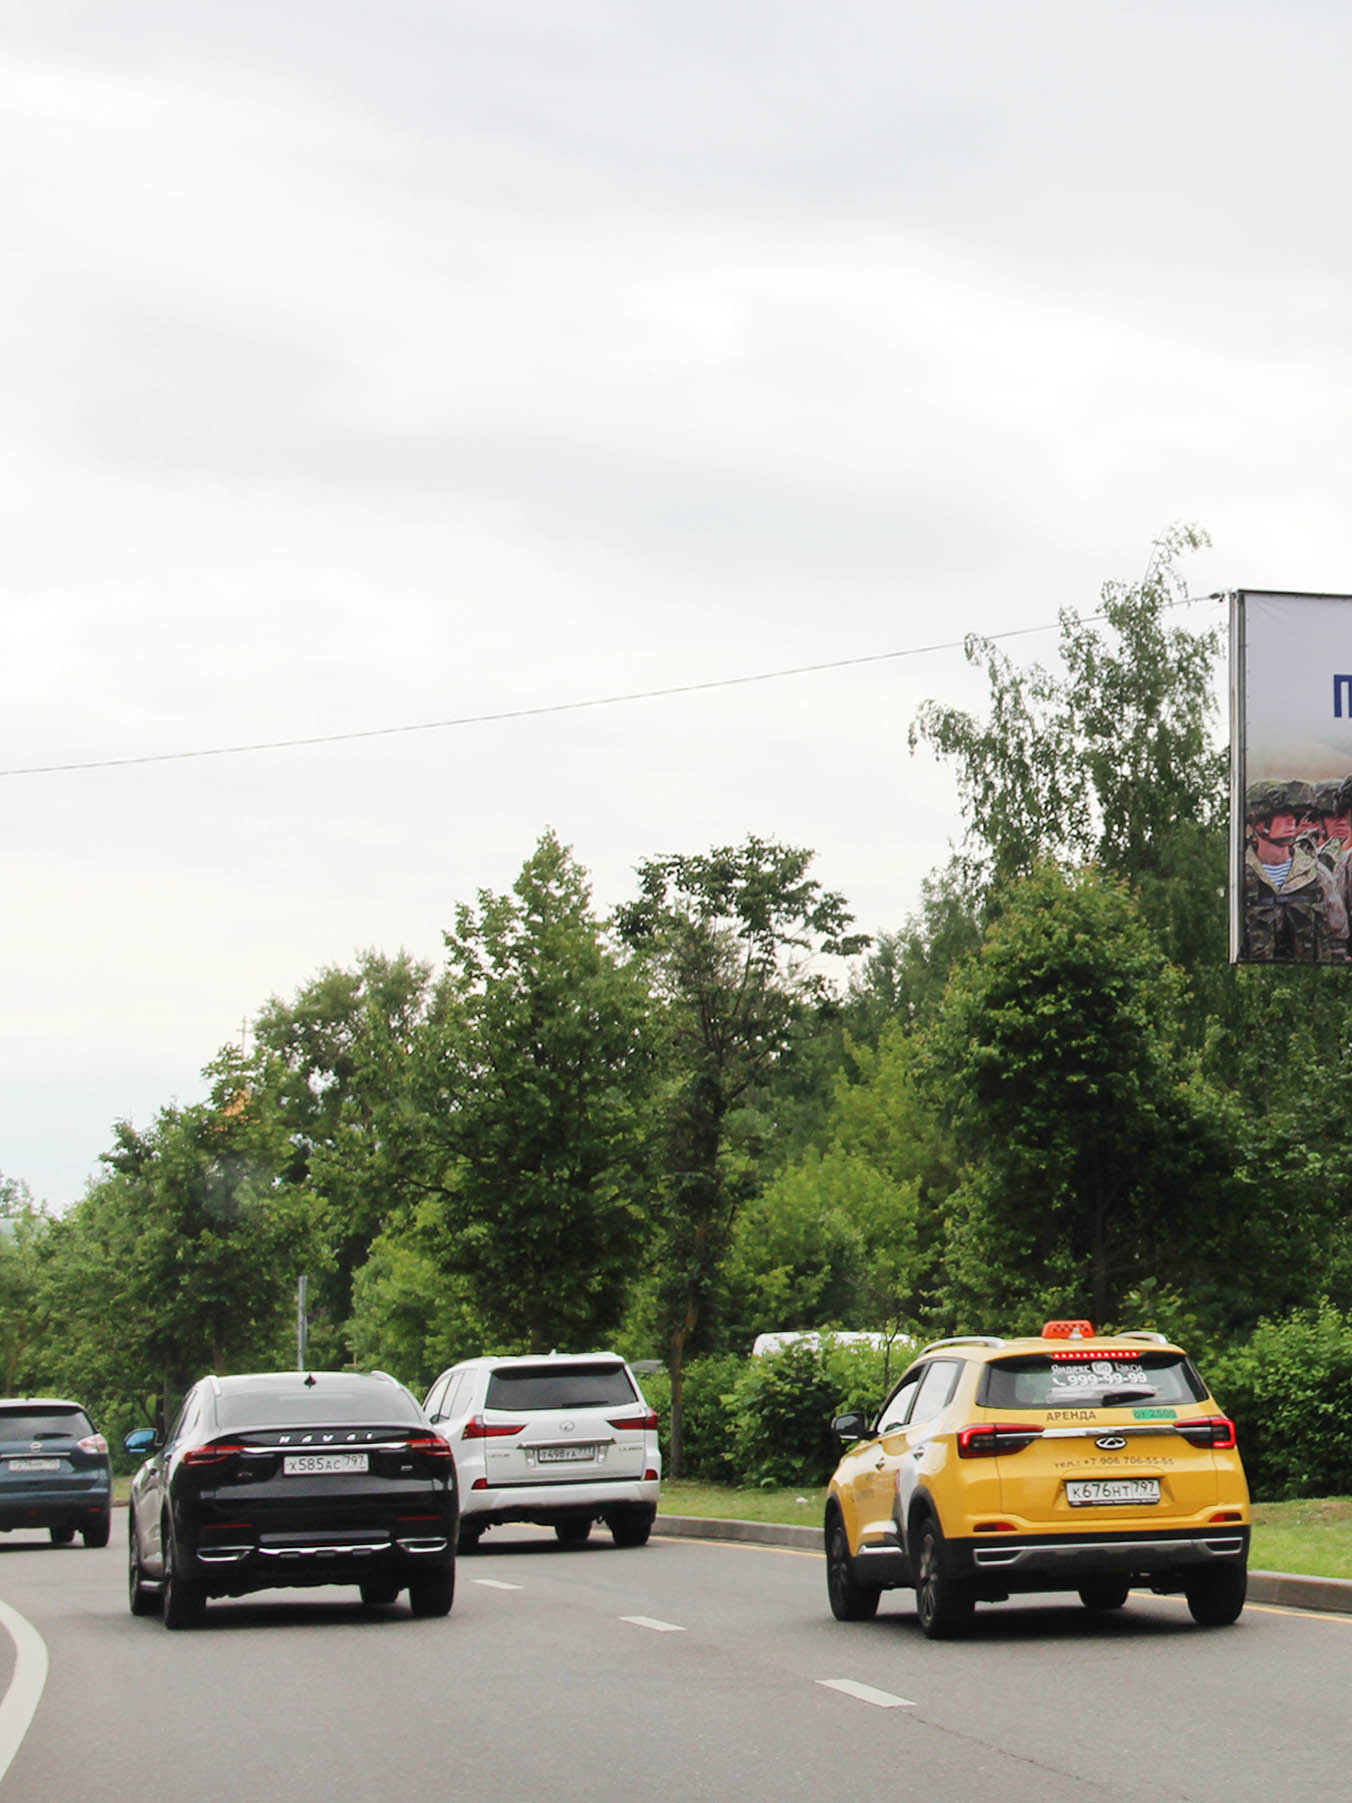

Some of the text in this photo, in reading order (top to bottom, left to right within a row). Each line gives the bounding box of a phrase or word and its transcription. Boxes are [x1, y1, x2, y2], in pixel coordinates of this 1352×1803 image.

[1051, 1364, 1091, 1375] Яндекс
[1067, 1372, 1148, 1385] 999-99-99
[1046, 1410, 1097, 1421] АРЕНДА
[278, 1433, 373, 1444] HAVAL
